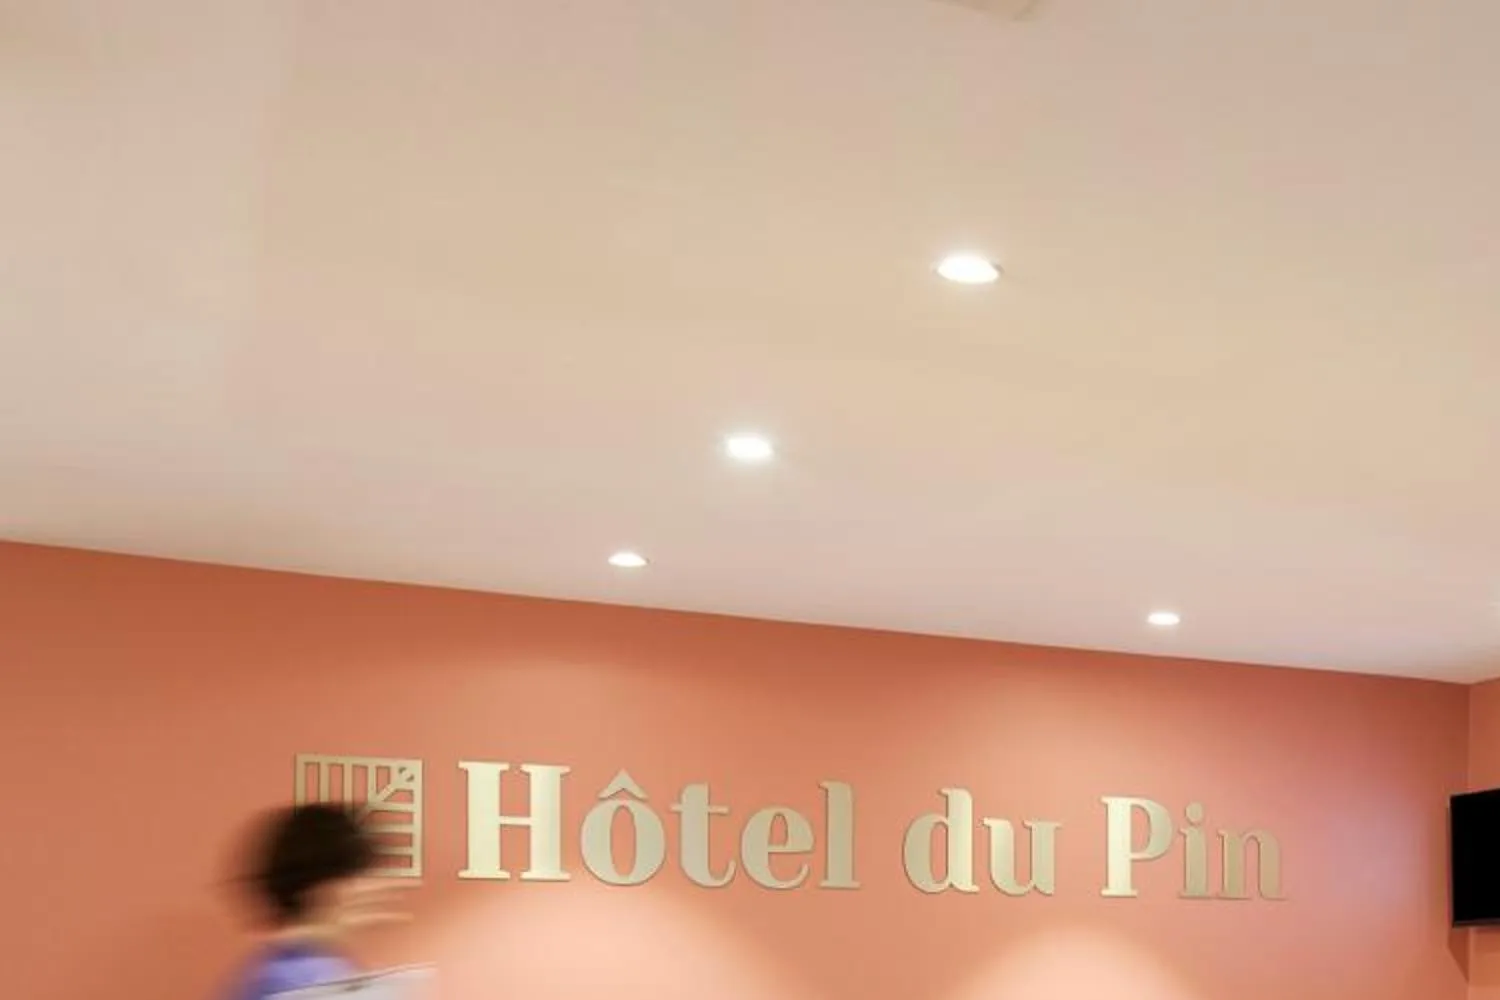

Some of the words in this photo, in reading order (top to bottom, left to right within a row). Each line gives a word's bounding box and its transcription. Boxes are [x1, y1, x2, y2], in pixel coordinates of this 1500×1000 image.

[457, 760, 862, 888] Hôtel
[903, 787, 1062, 897] du
[1100, 796, 1287, 900] Pin
